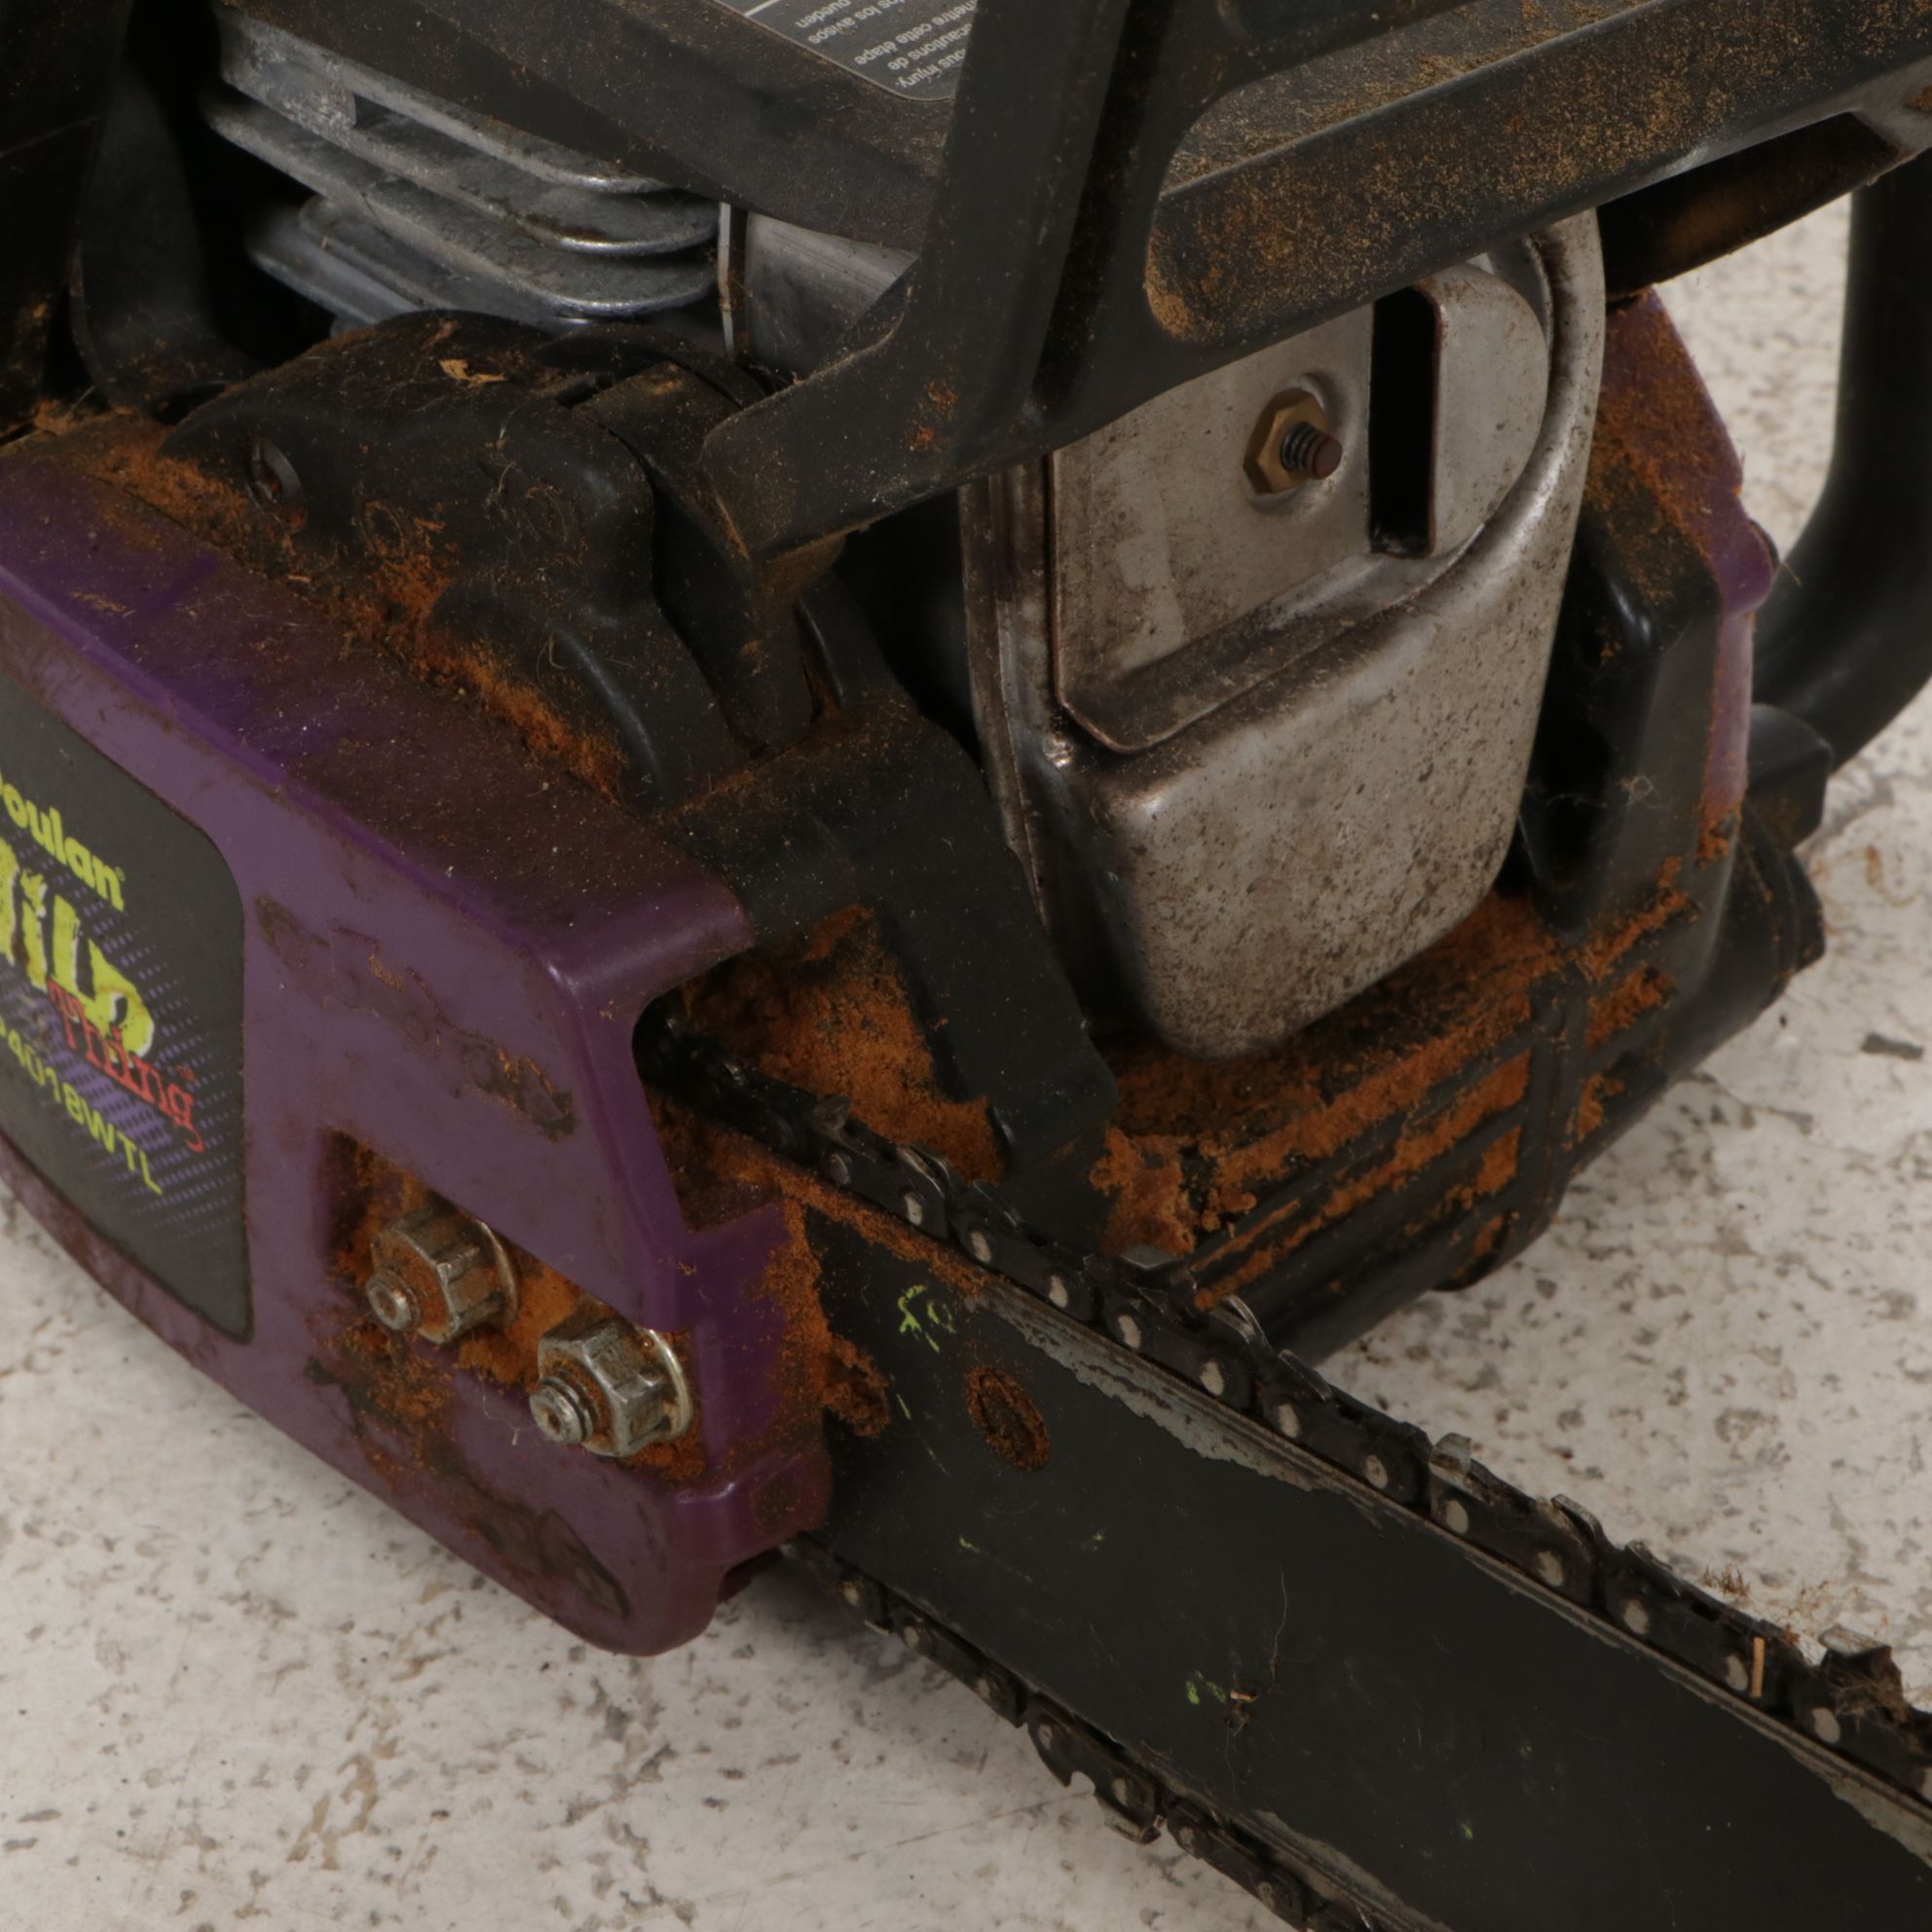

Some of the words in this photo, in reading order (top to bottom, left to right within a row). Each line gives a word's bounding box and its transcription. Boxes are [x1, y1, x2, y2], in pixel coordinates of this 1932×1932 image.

[854, 5, 882, 21] los
[808, 17, 856, 45] avisos
[896, 22, 933, 46] cette
[854, 40, 898, 66] étape
[887, 56, 910, 71] de
[0, 771, 125, 912] oulan
[47, 978, 204, 1153] Thing
